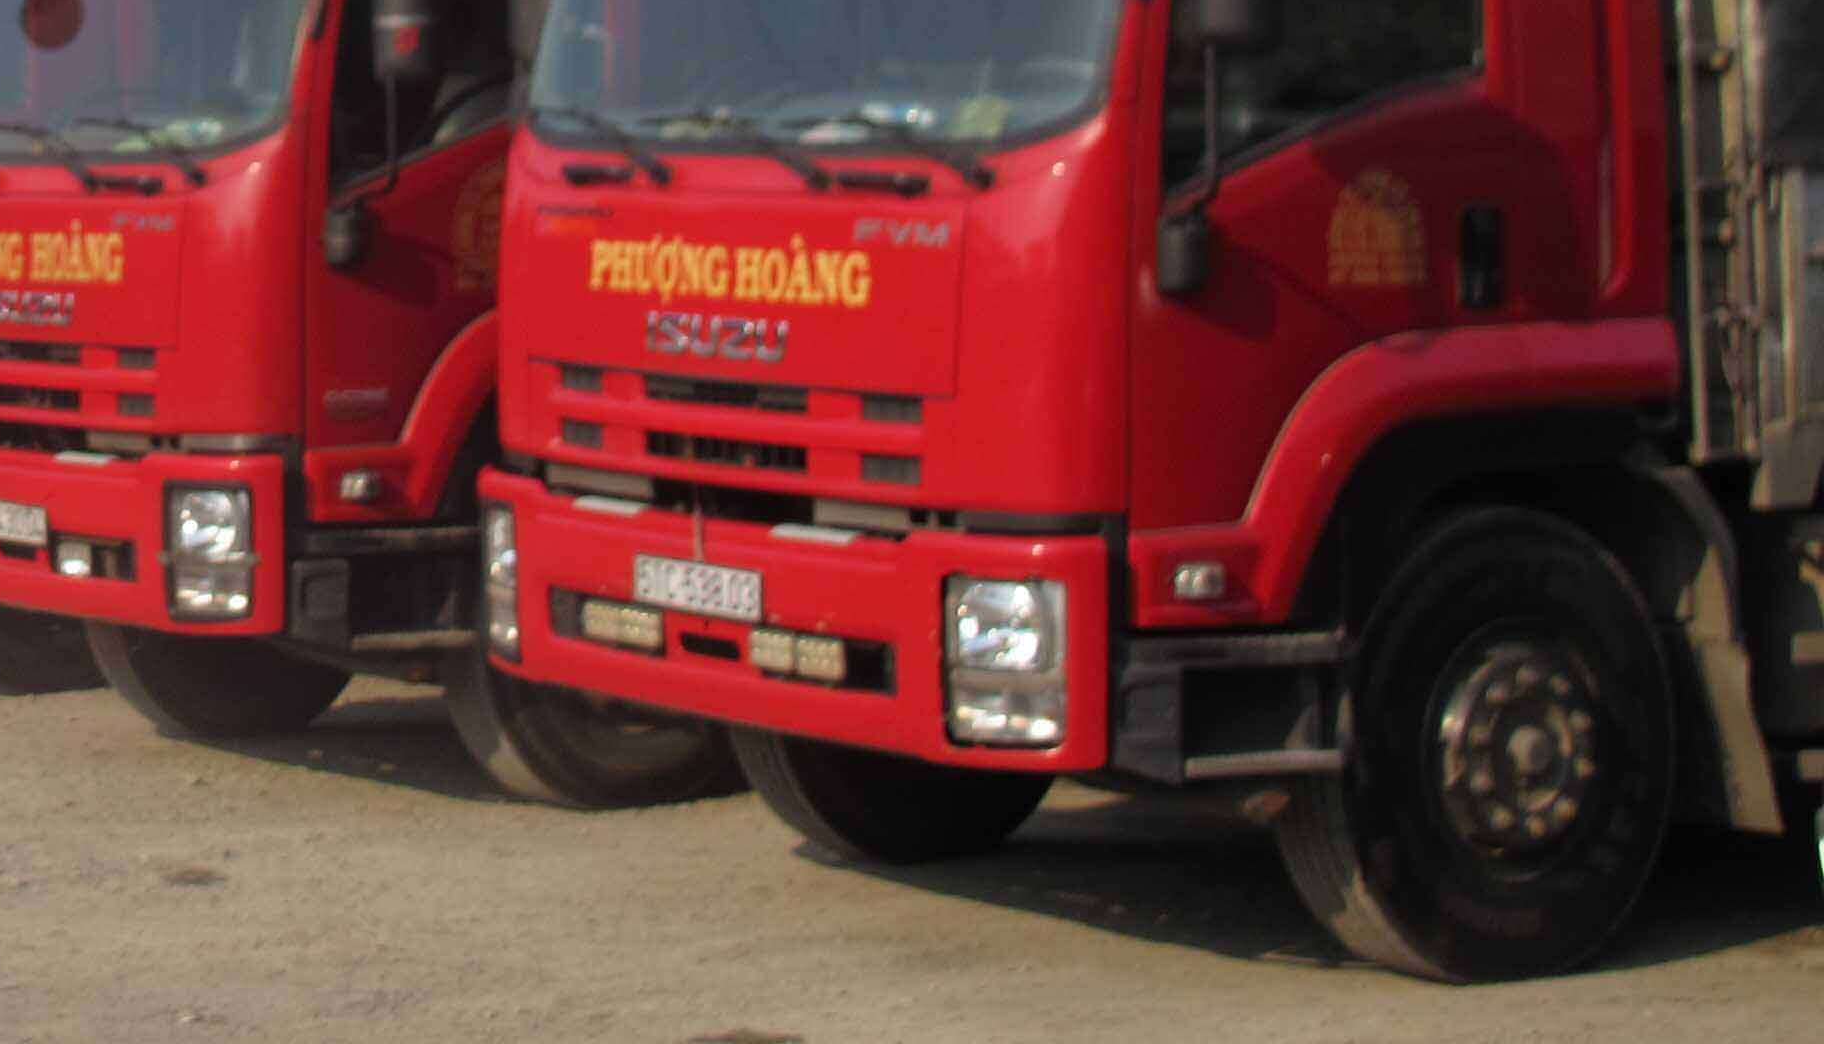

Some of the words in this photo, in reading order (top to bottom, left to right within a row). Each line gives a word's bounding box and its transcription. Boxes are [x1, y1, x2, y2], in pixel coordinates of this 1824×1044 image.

[590, 231, 730, 305] PHƯỢNG
[733, 232, 871, 307] HOÀNG
[646, 310, 789, 362] ISUZU
